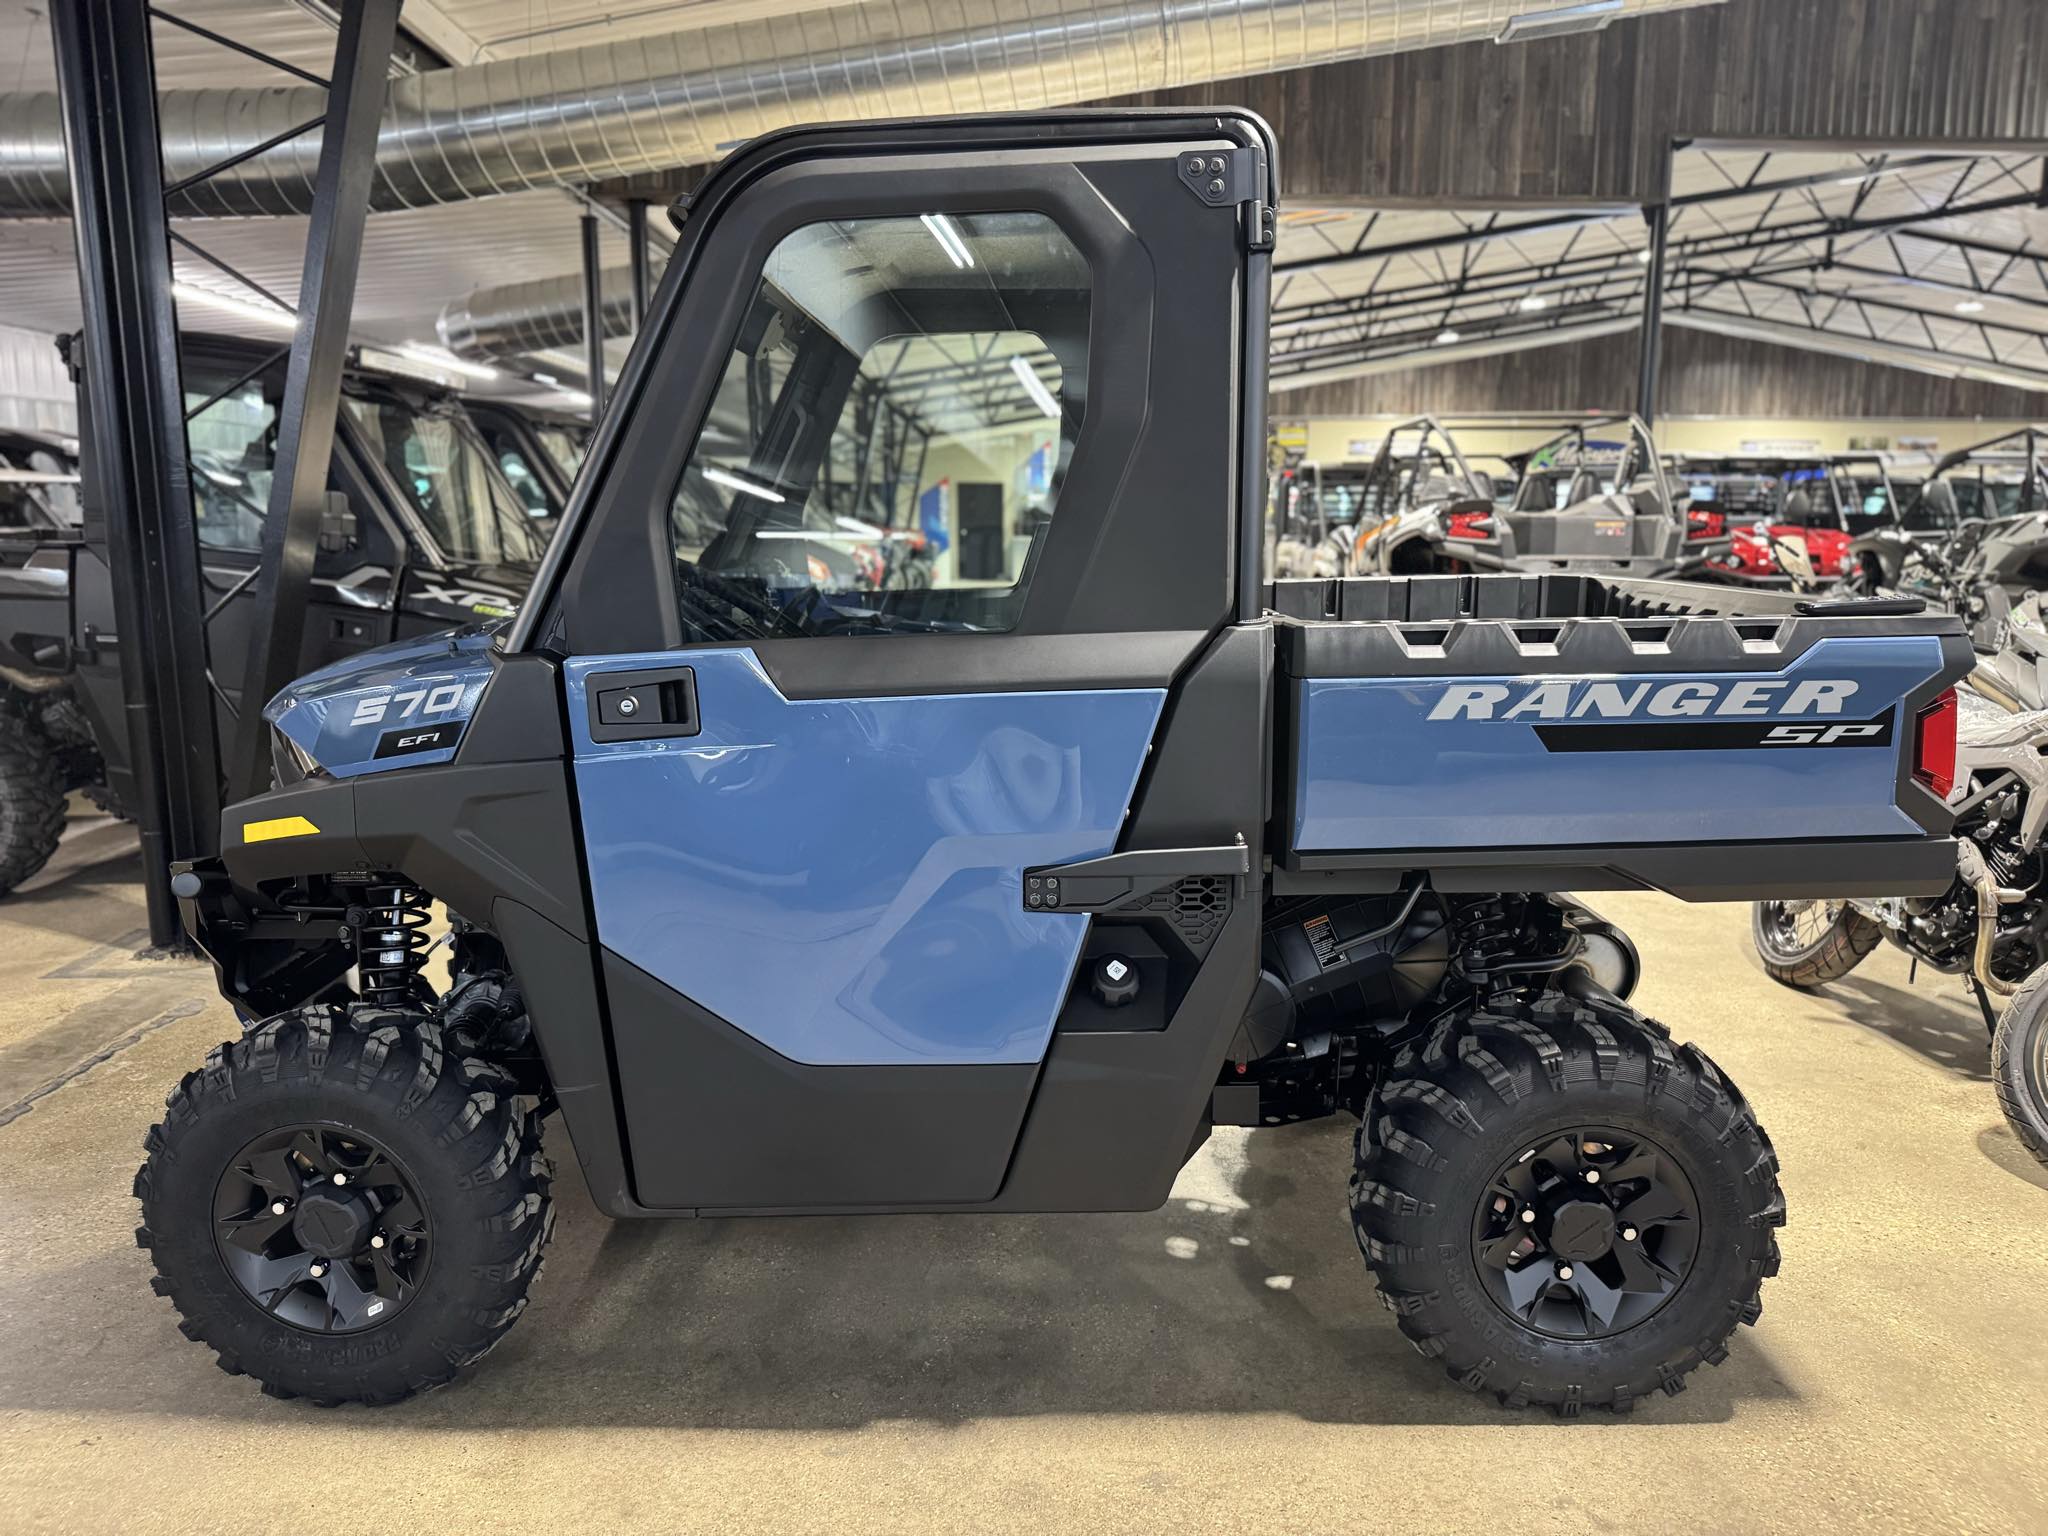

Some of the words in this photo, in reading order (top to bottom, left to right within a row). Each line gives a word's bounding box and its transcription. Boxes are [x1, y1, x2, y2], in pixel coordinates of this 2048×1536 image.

[409, 584, 512, 607] XP
[350, 684, 466, 727] 570
[1426, 680, 1859, 720] RANGER
[397, 732, 441, 748] EFI
[1760, 724, 1884, 744] SP
